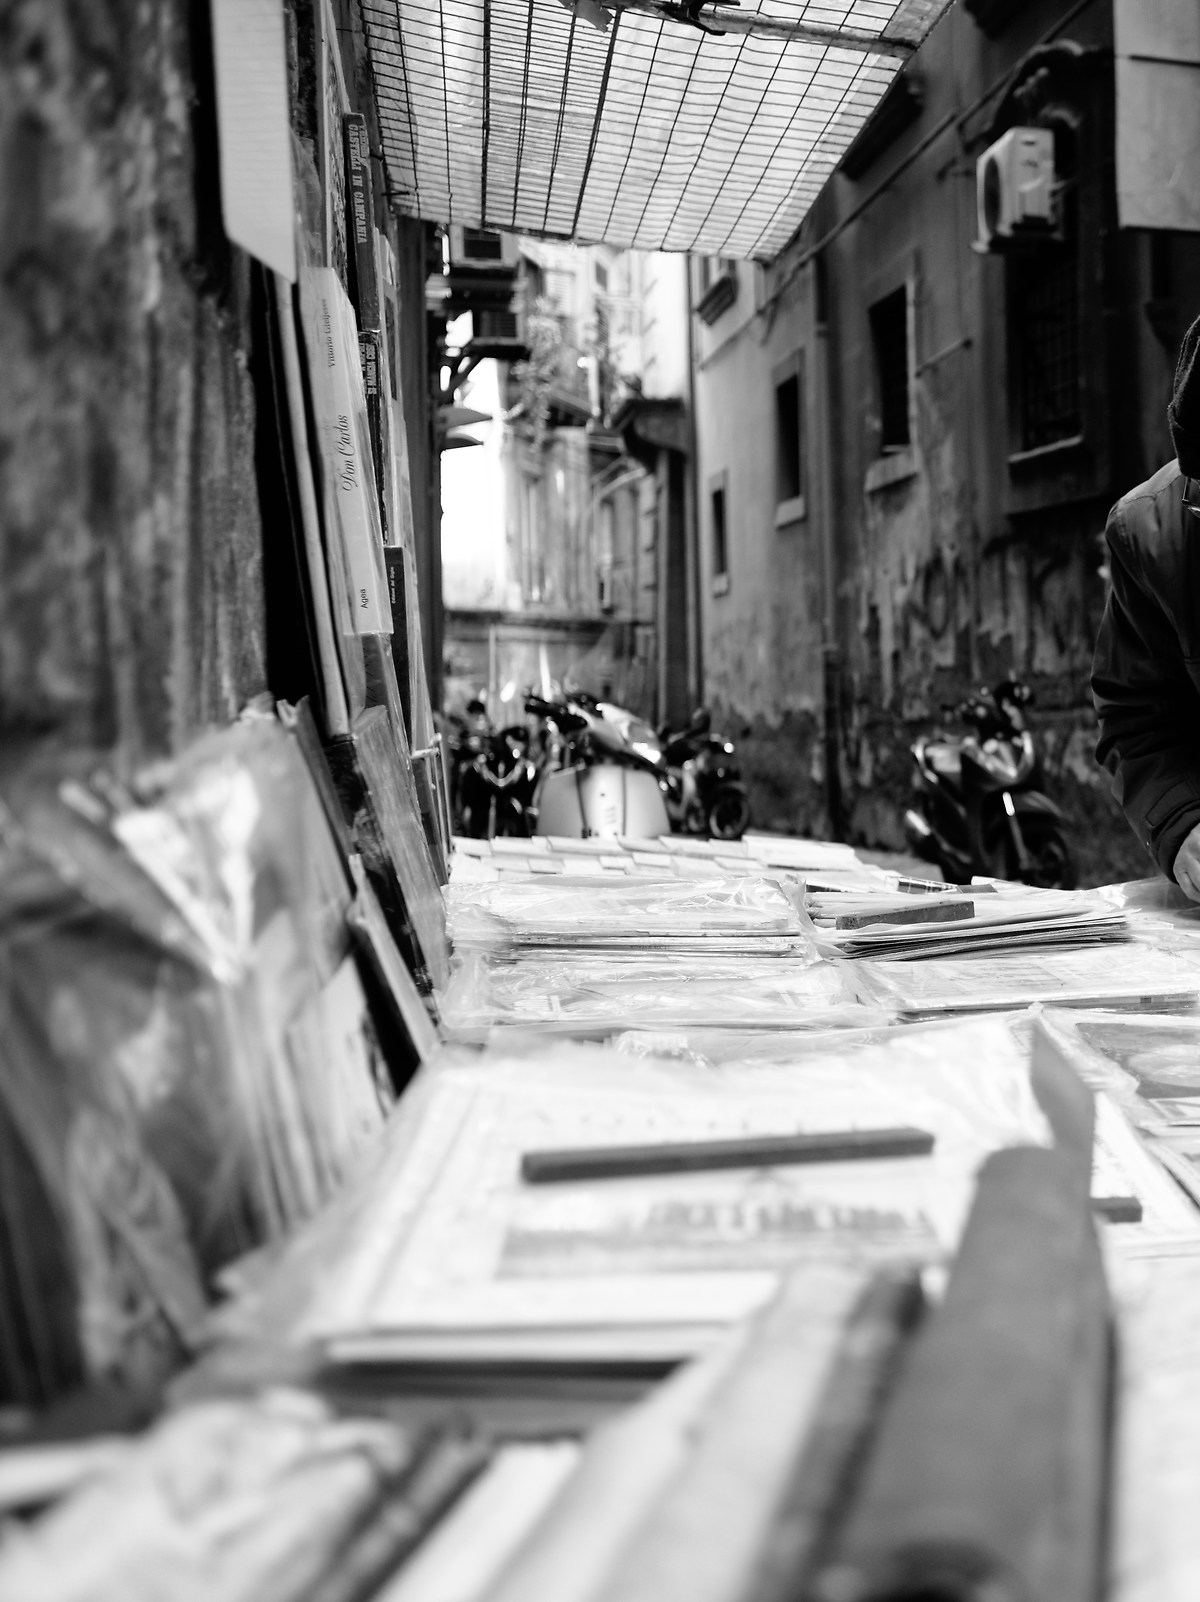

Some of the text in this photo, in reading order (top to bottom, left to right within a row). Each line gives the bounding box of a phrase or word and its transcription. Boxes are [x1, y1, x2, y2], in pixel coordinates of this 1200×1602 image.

[348, 124, 368, 244] CASTELLI IN CAMPANIA
[324, 336, 335, 368] Vittorio
[332, 414, 358, 492] Don Carlos
[360, 588, 368, 609] Agea
